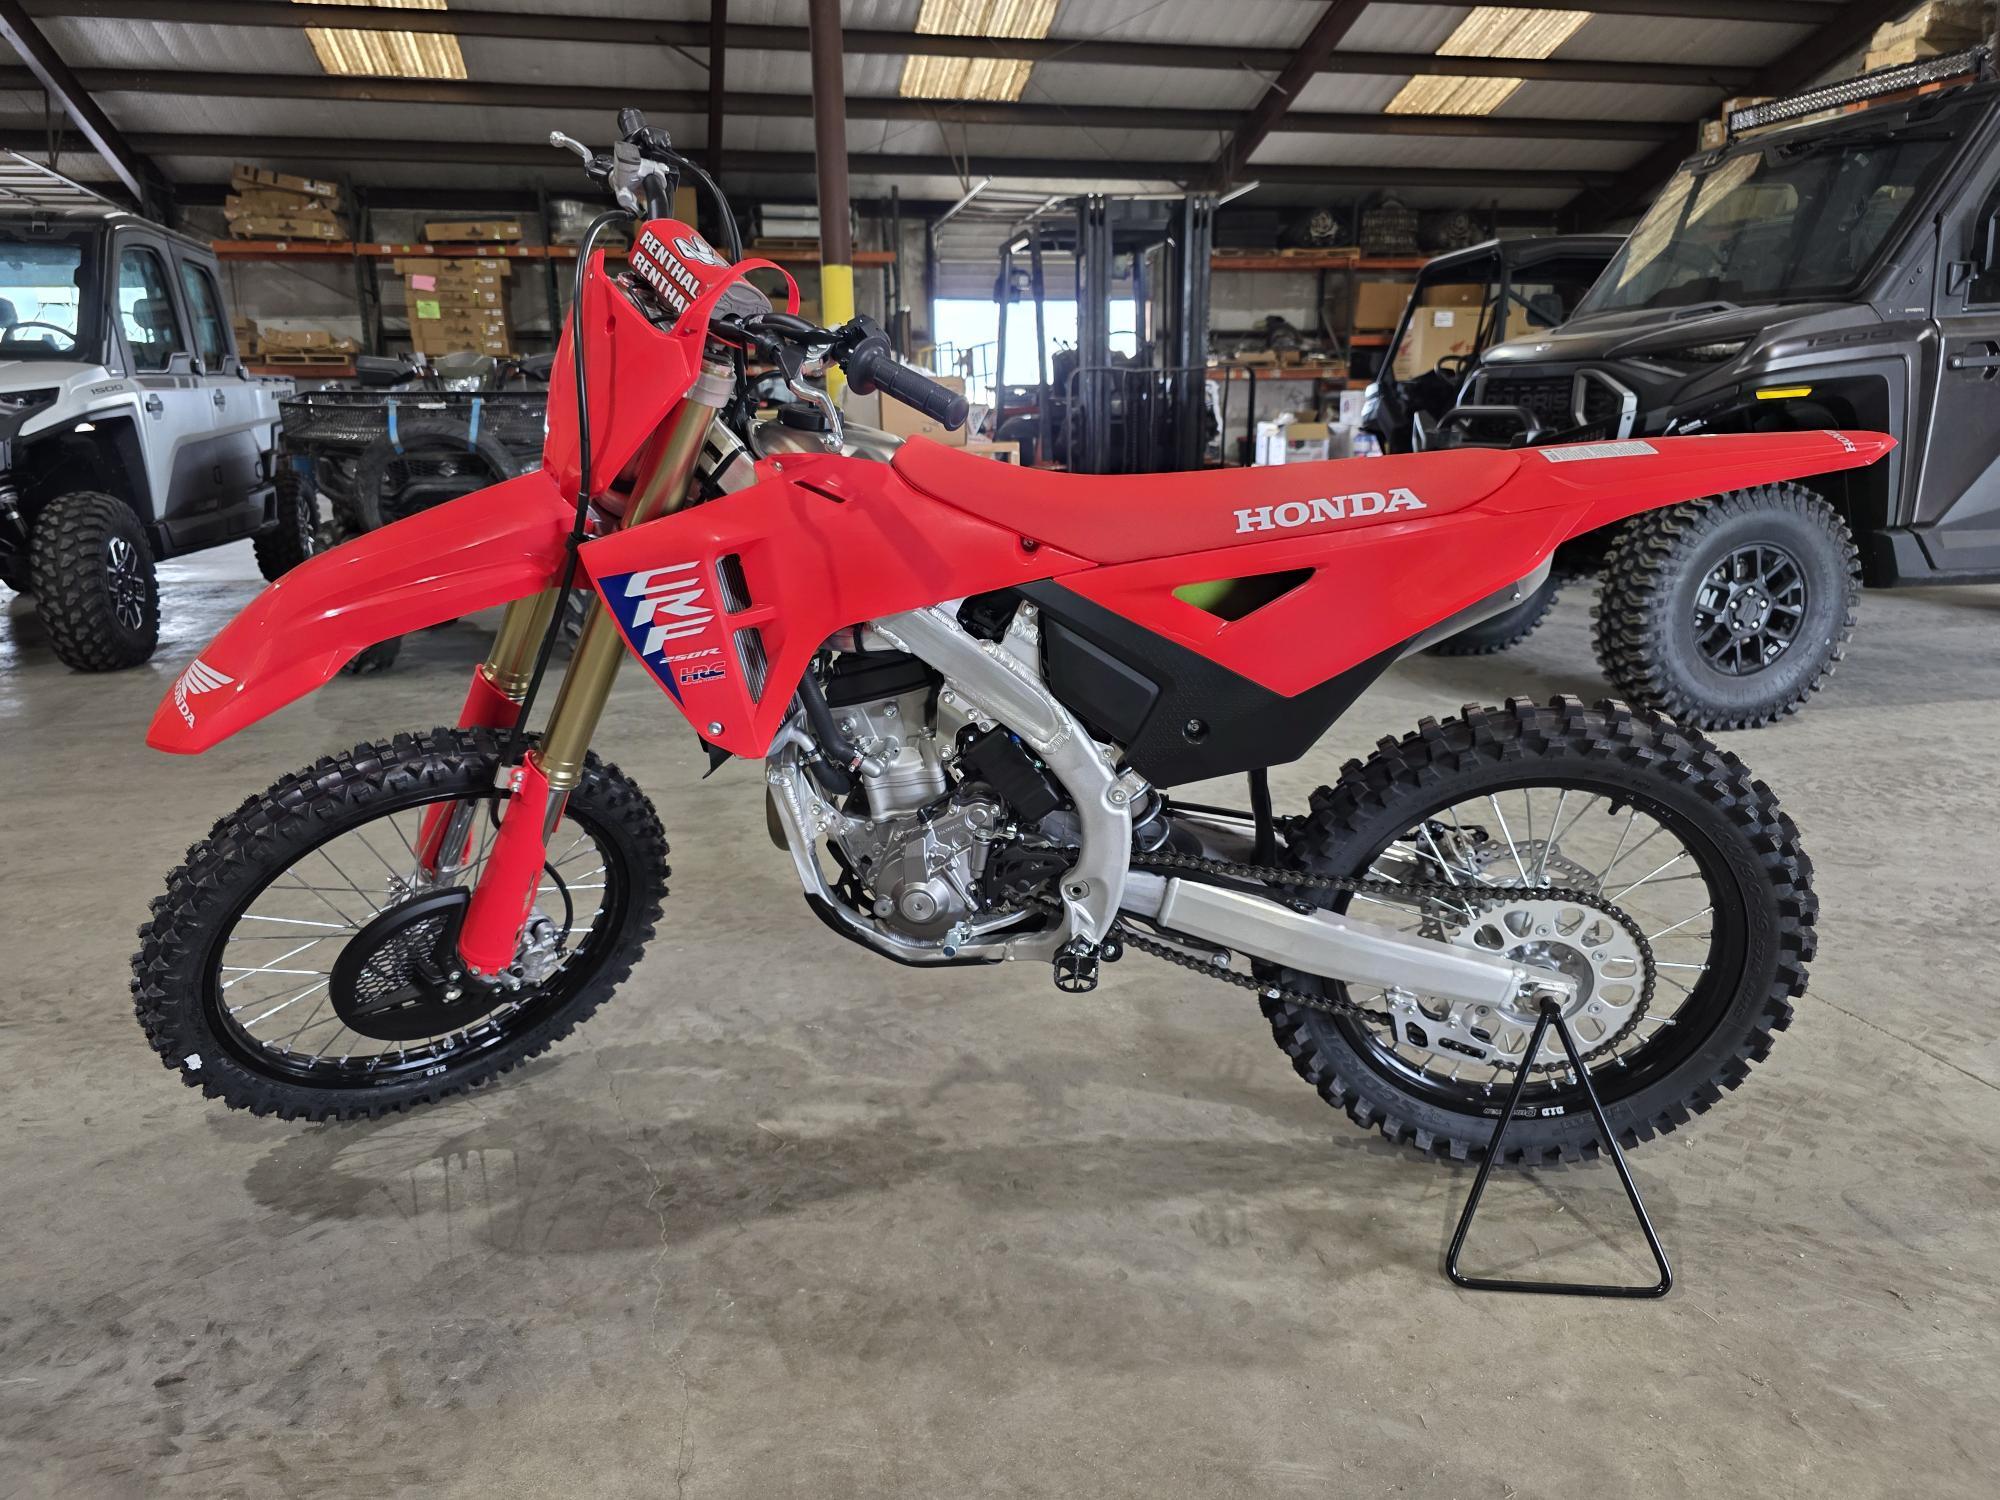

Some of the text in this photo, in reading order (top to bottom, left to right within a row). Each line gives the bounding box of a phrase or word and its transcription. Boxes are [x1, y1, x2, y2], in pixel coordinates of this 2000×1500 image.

[639, 230, 700, 299] RENTHAL
[90, 384, 124, 396] 1500
[1233, 487, 1427, 534] HONDA
[623, 560, 716, 657] CRF
[658, 647, 723, 665] 250R
[680, 660, 727, 685] HRC
